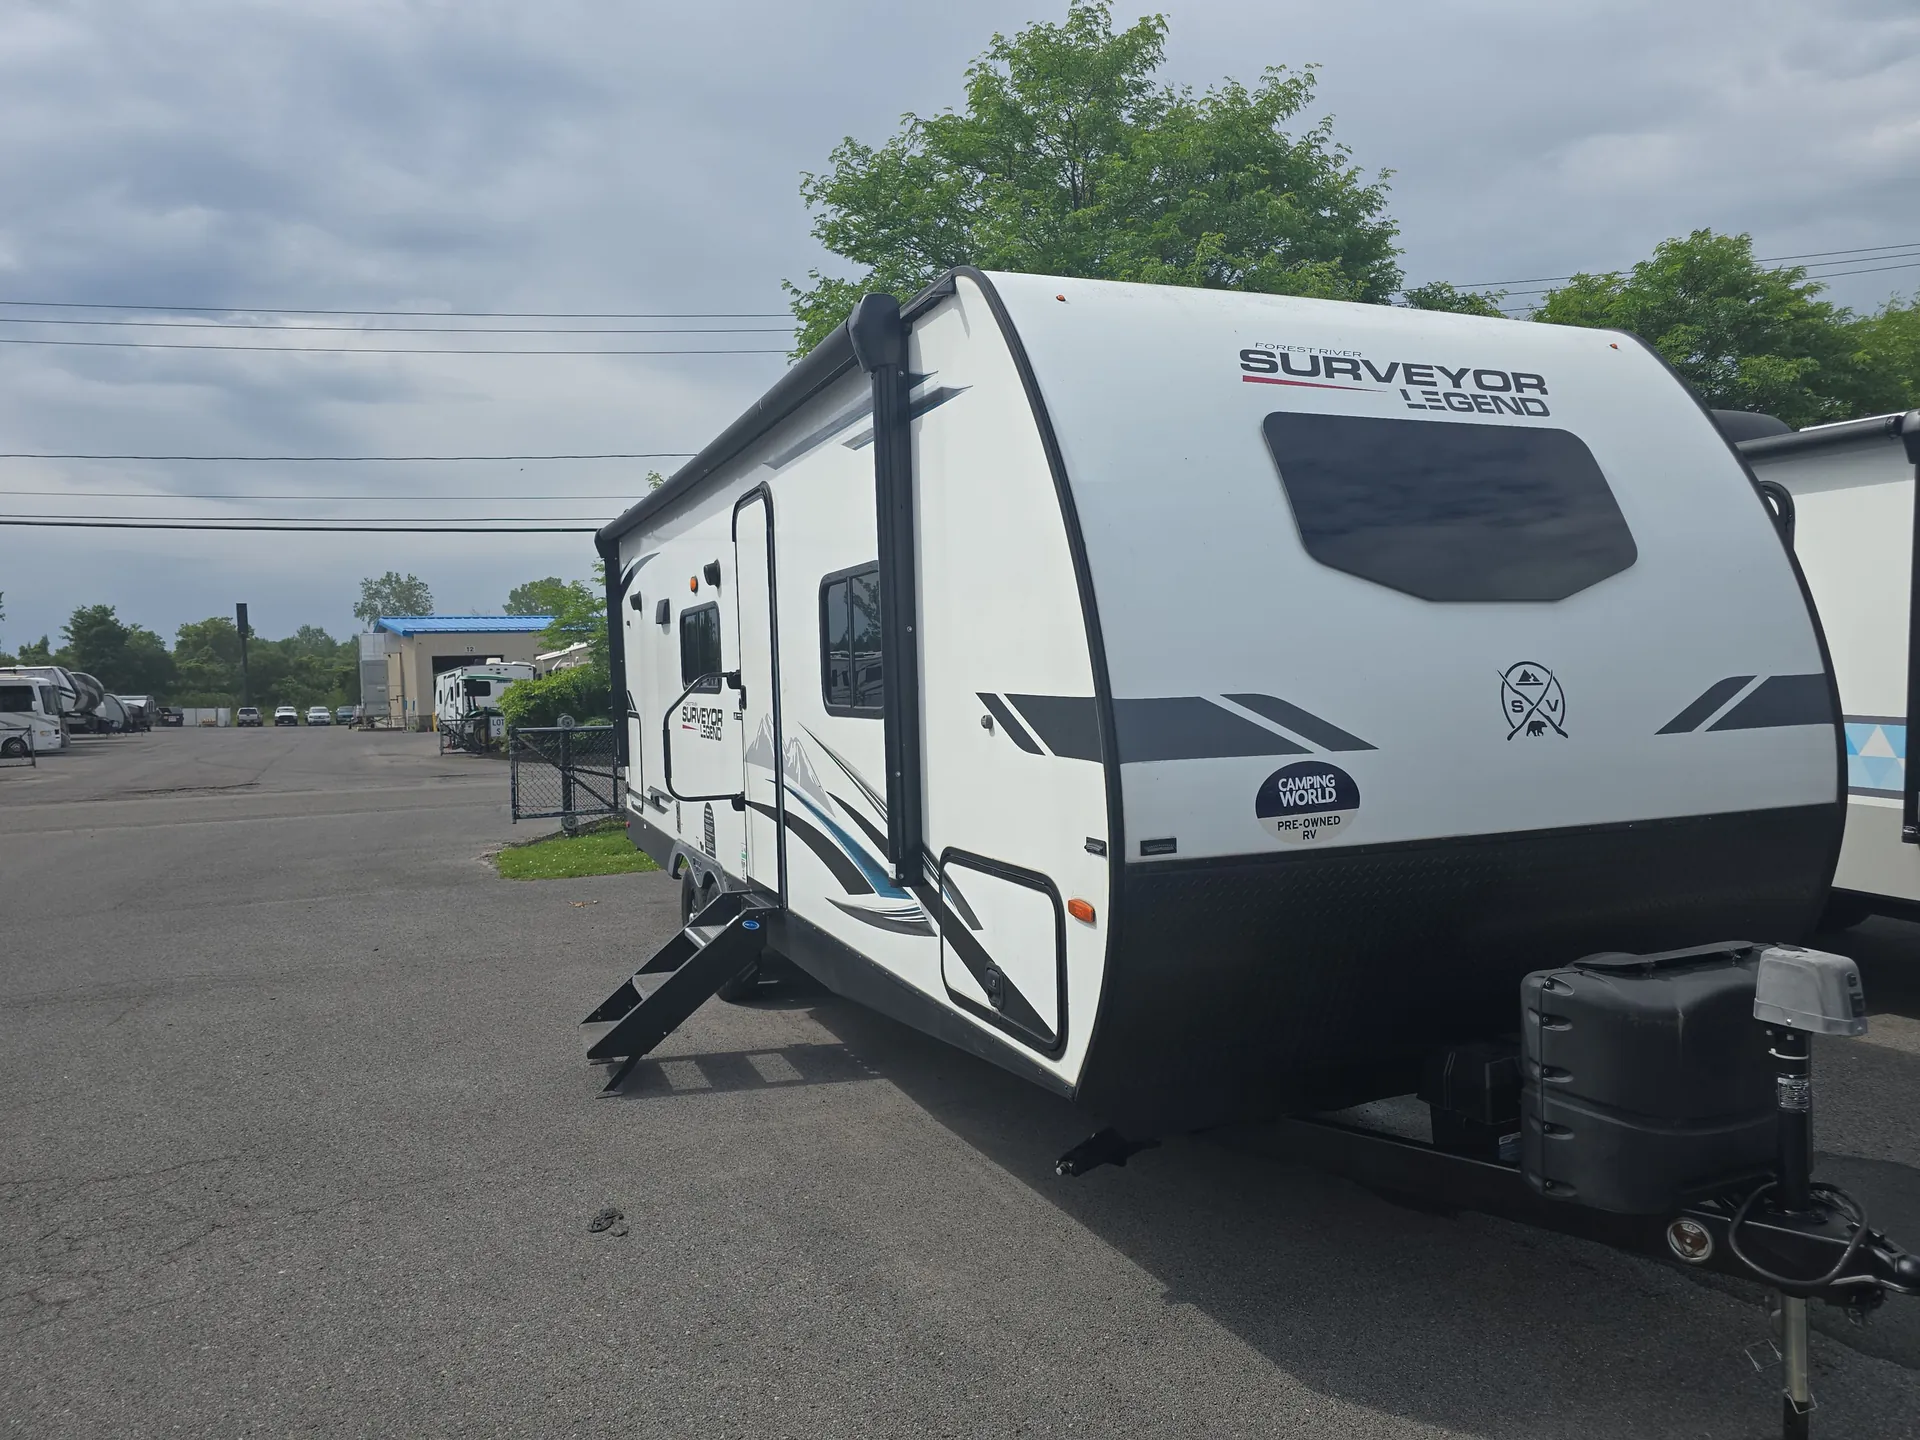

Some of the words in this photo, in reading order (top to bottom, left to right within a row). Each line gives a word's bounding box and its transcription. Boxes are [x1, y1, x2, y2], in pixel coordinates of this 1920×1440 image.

[1255, 342, 1316, 354] FOREST
[1319, 348, 1362, 358] RIVER
[1239, 348, 1549, 395] SURVEYOR
[1399, 388, 1550, 417] LEGEND
[1511, 699, 1524, 713] S
[1545, 699, 1559, 712] V
[682, 705, 723, 727] SURVEYOR
[700, 724, 722, 741] LEGEND
[1278, 774, 1335, 792] CAMPING
[1280, 787, 1337, 807] WORLD
[1277, 815, 1341, 831] PRE-OWNED
[1302, 829, 1317, 840] RV
